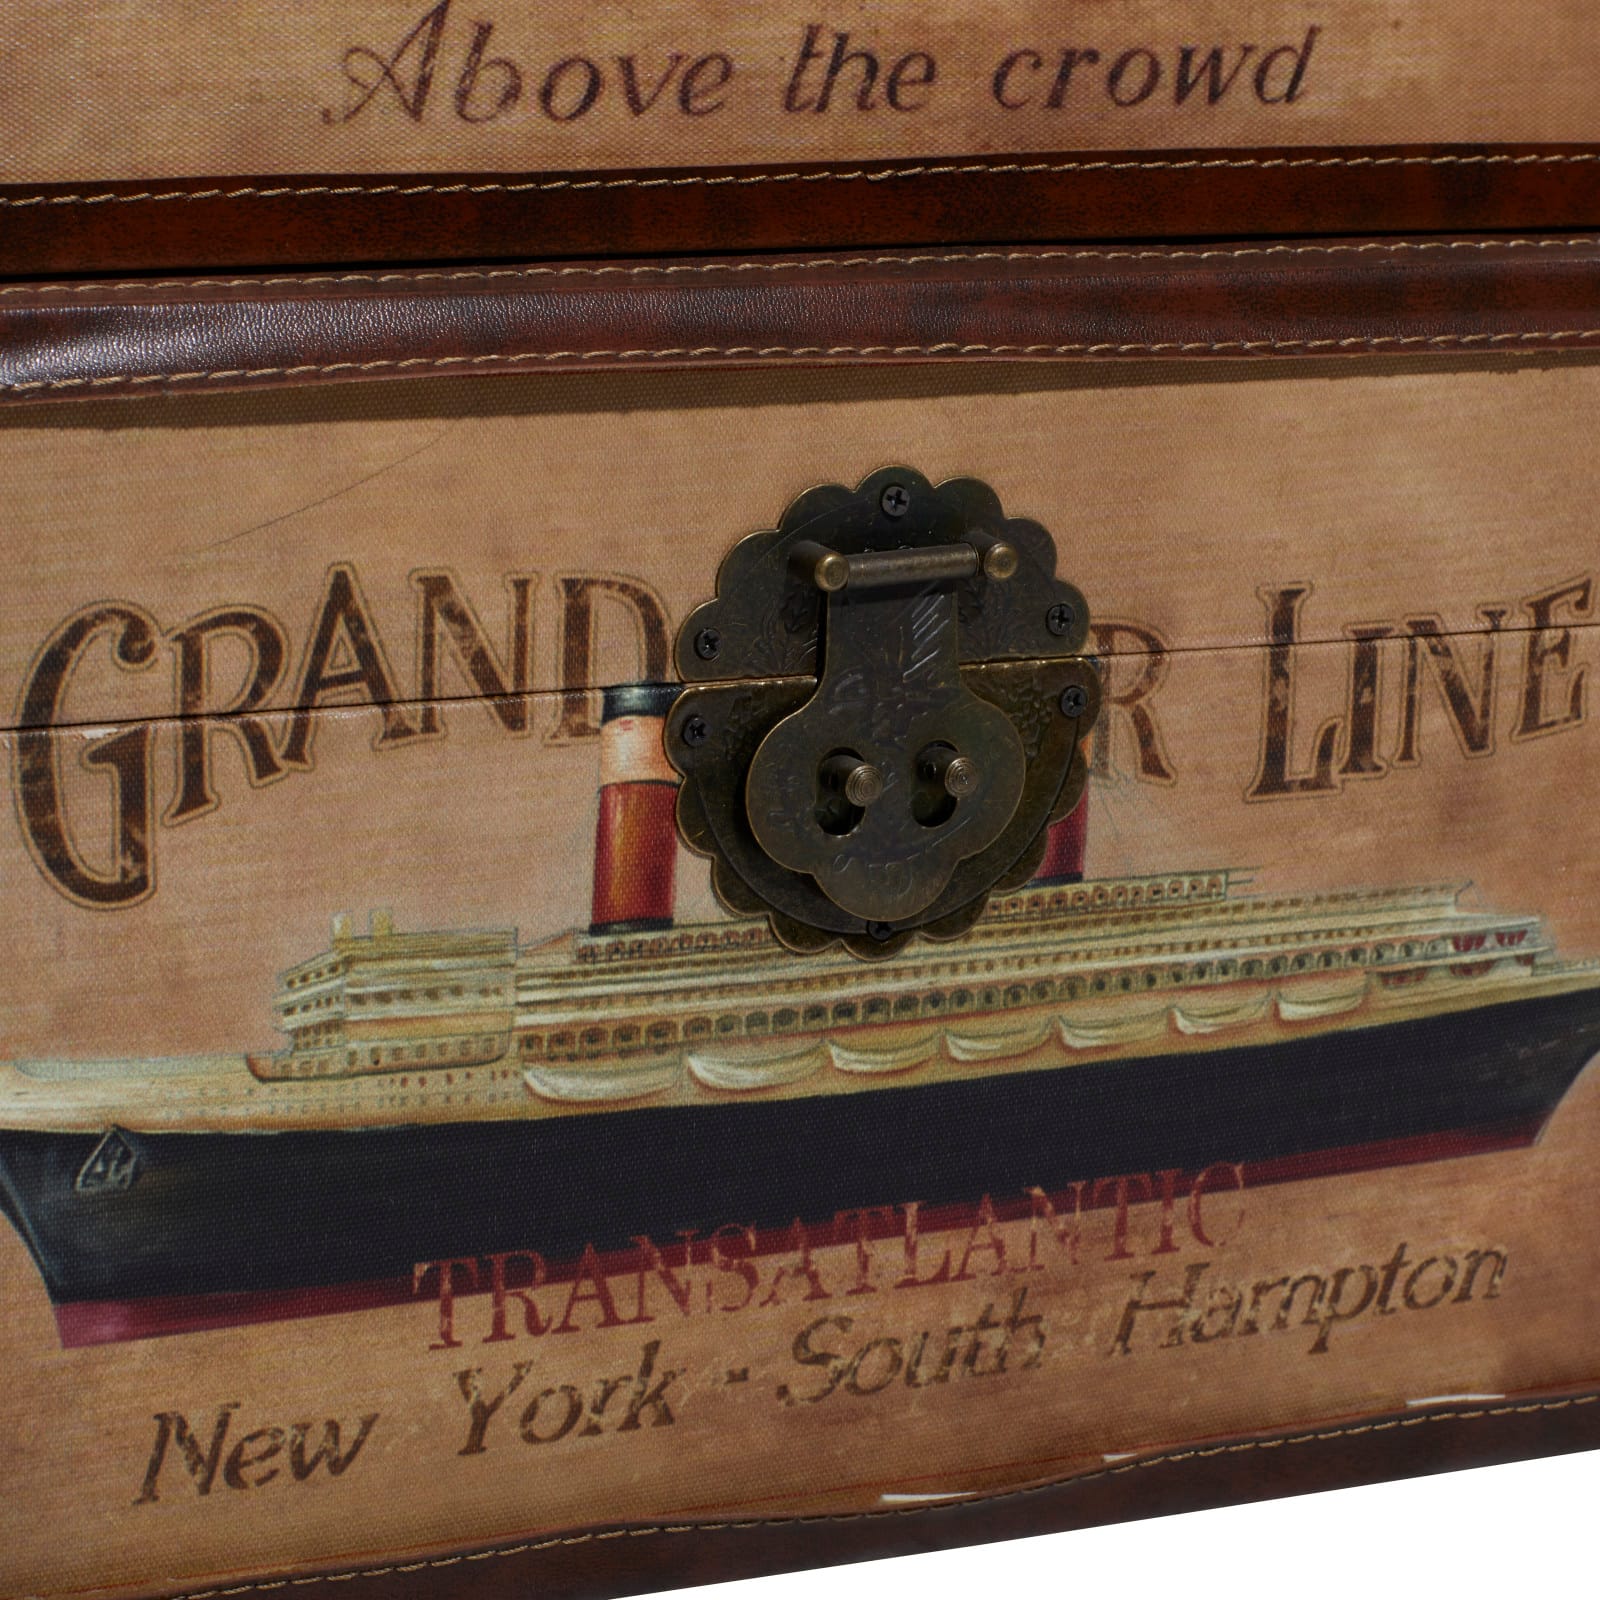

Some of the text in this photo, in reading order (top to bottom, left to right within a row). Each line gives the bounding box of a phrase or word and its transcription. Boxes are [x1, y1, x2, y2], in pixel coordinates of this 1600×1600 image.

[322, 0, 1321, 126] Above the crowd
[1245, 575, 1598, 802] LINE
[411, 1161, 1246, 1350] TRANSATLANTIC
[134, 1403, 379, 1503] New
[453, 1339, 684, 1455] York
[778, 1290, 1047, 1405] South
[1120, 1241, 1507, 1354] Hampton
